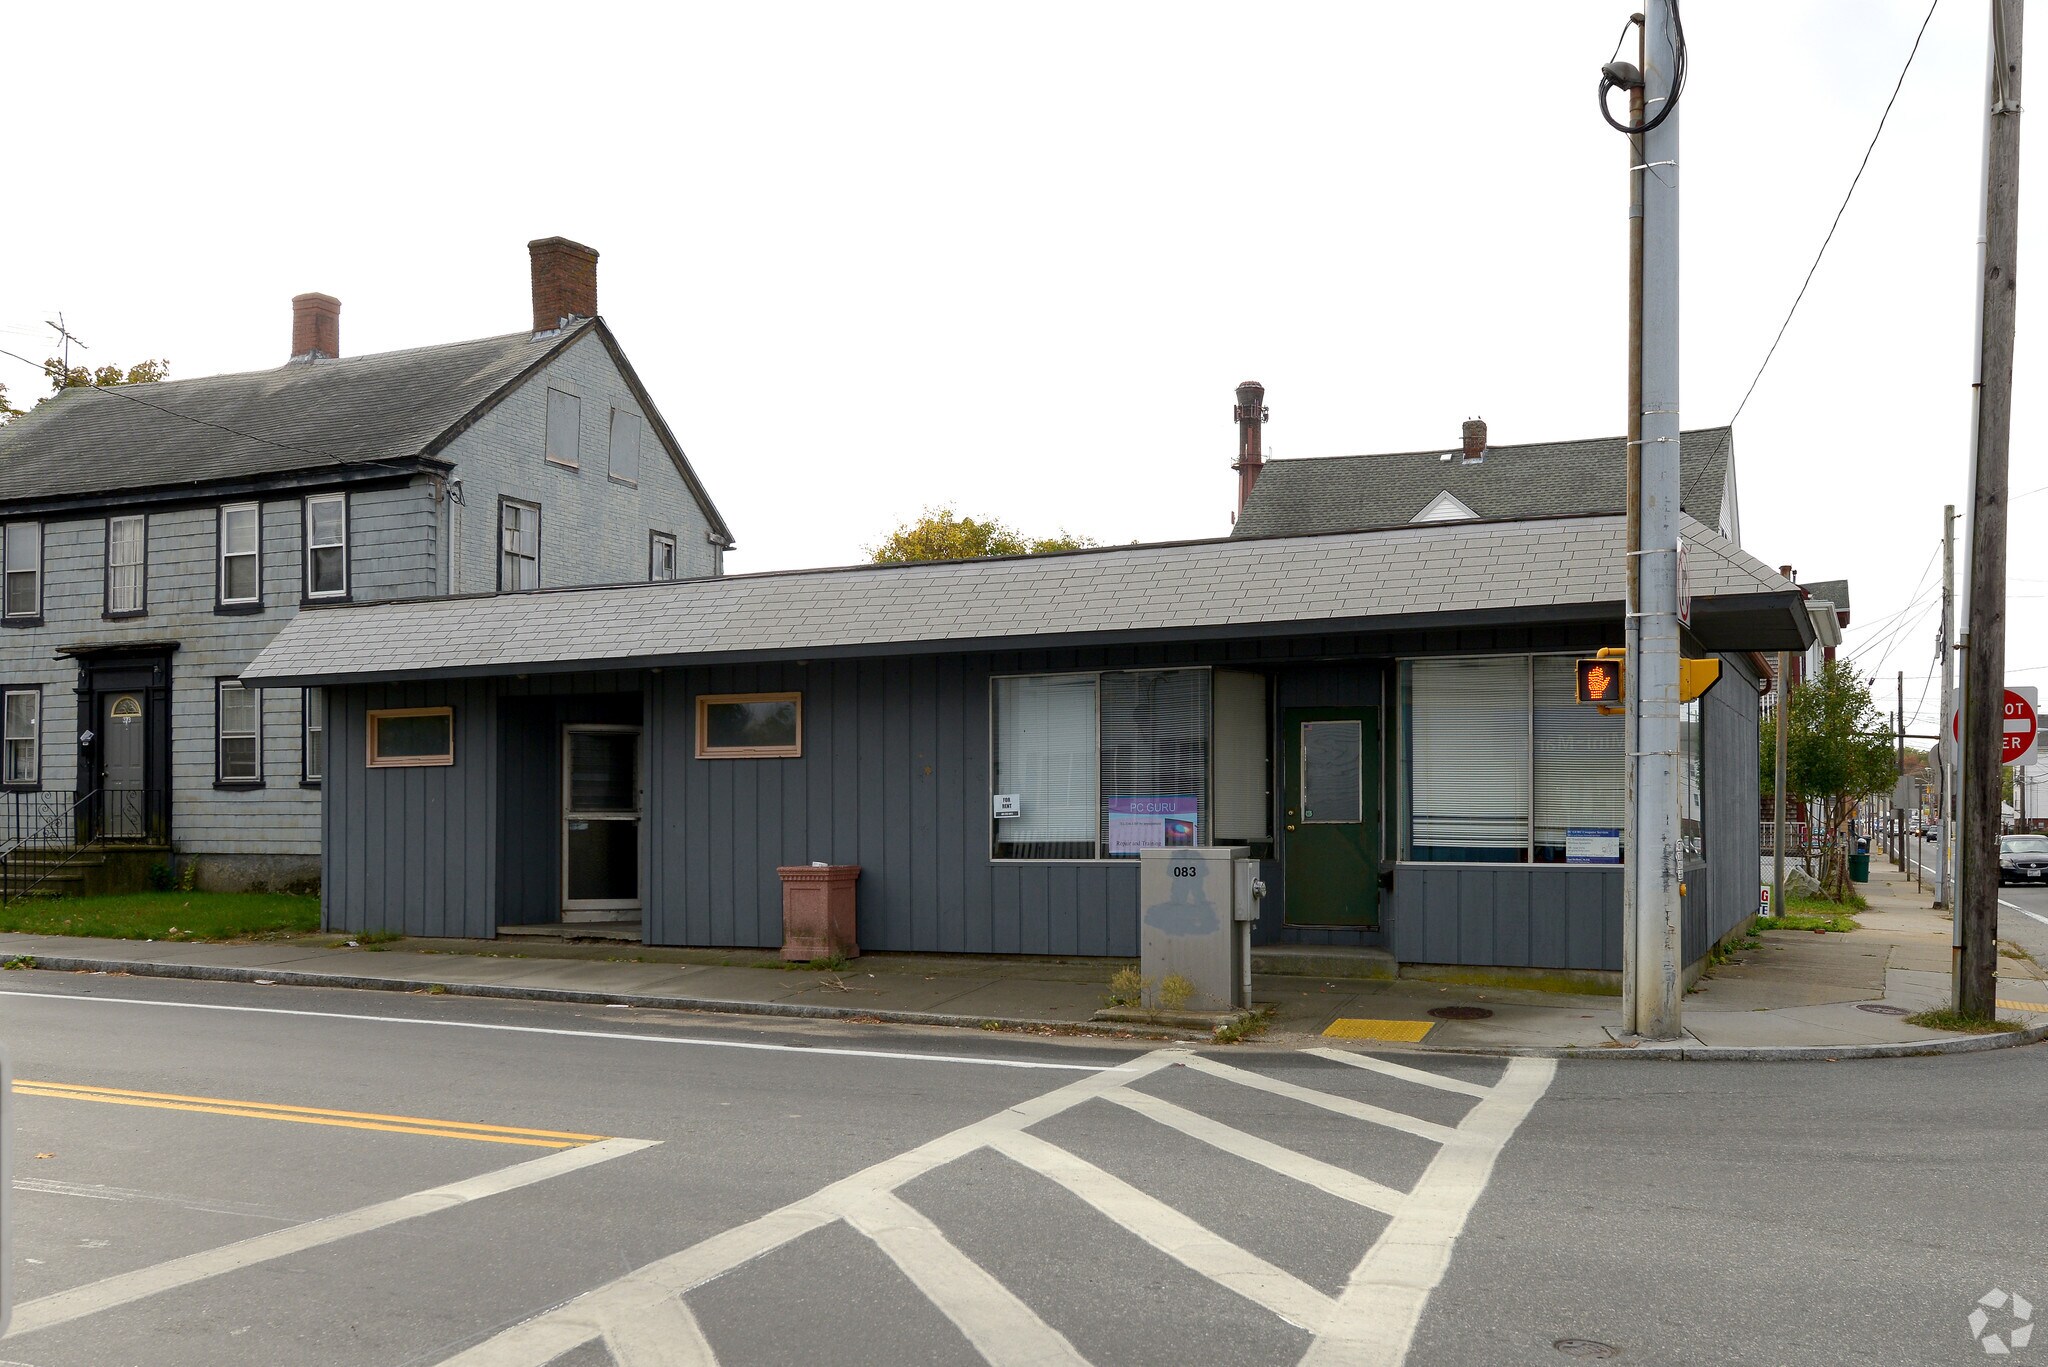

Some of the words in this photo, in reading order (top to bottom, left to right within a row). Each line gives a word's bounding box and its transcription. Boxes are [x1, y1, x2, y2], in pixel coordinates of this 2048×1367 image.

[2004, 703, 2024, 715] OT
[2002, 737, 2021, 749] ER
[1130, 802, 1144, 812] PC
[1146, 802, 1176, 812] GURU
[1173, 866, 1197, 878] 083
